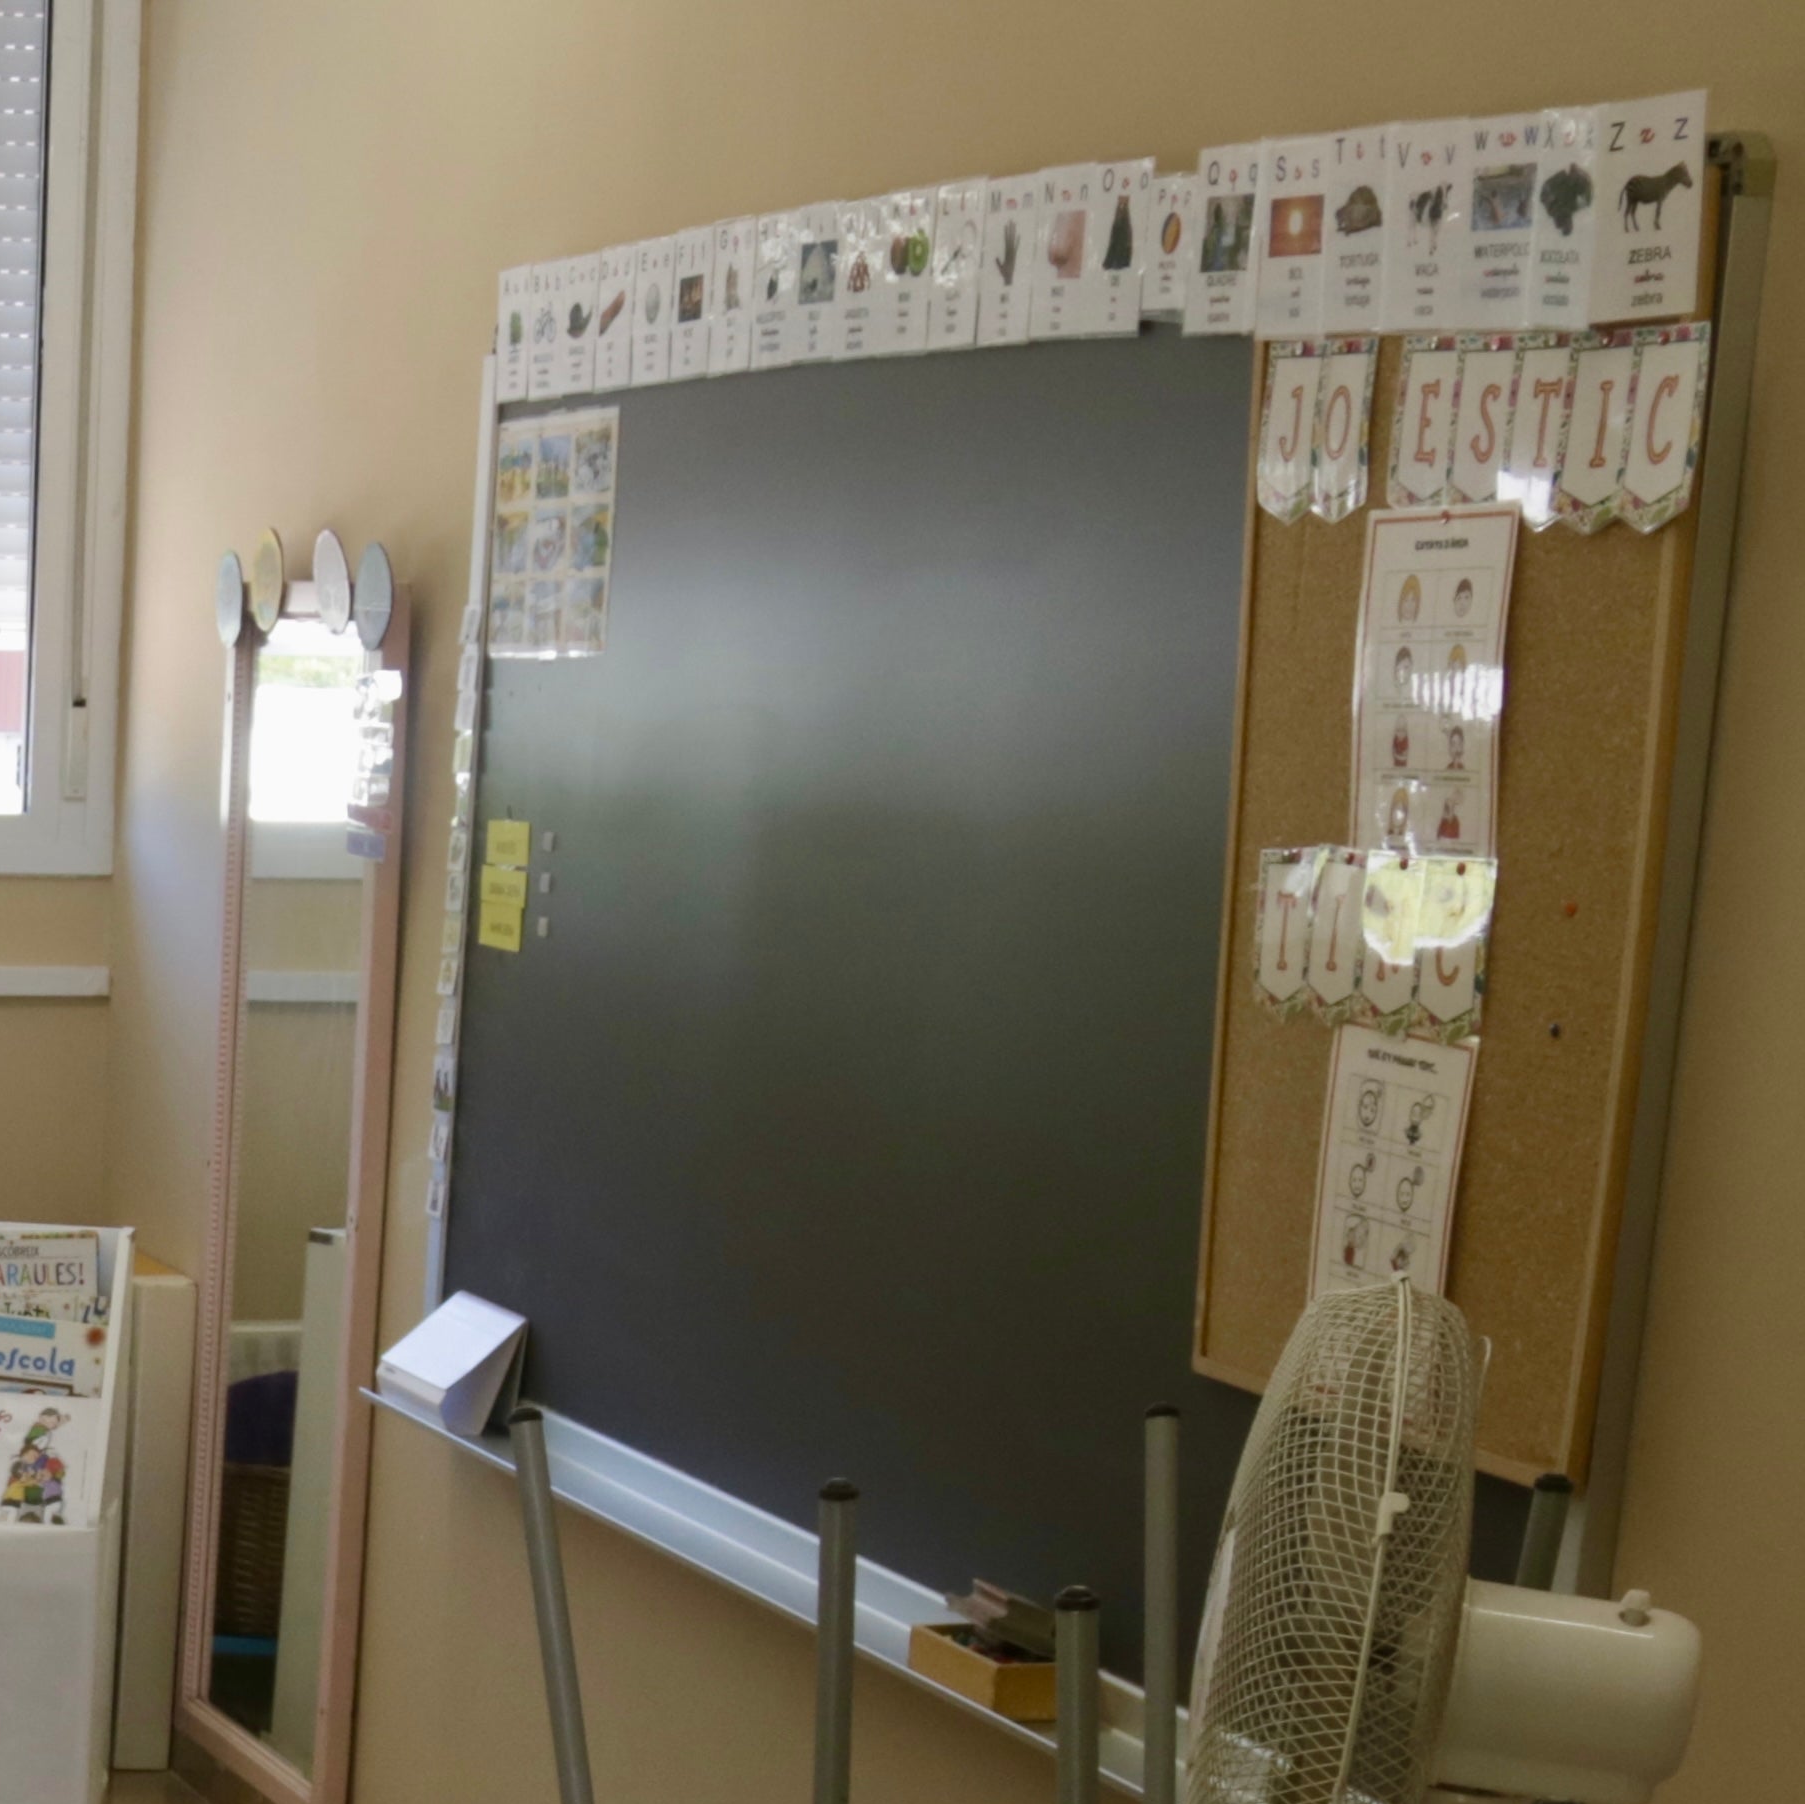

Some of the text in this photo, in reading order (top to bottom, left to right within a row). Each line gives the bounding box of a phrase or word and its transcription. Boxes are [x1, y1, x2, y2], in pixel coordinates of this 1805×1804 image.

[1475, 130, 1489, 150] W
[1543, 120, 1555, 149] X
[1608, 121, 1626, 152] Z
[1336, 138, 1345, 164] T
[1398, 142, 1411, 168] V
[1102, 168, 1115, 193] O
[1207, 160, 1221, 186] Q
[1276, 155, 1287, 182] S
[1044, 182, 1055, 203] N
[1628, 246, 1672, 265] ZEBRA
[1631, 293, 1663, 308] zebra
[1277, 375, 1680, 468] JO ESTIC
